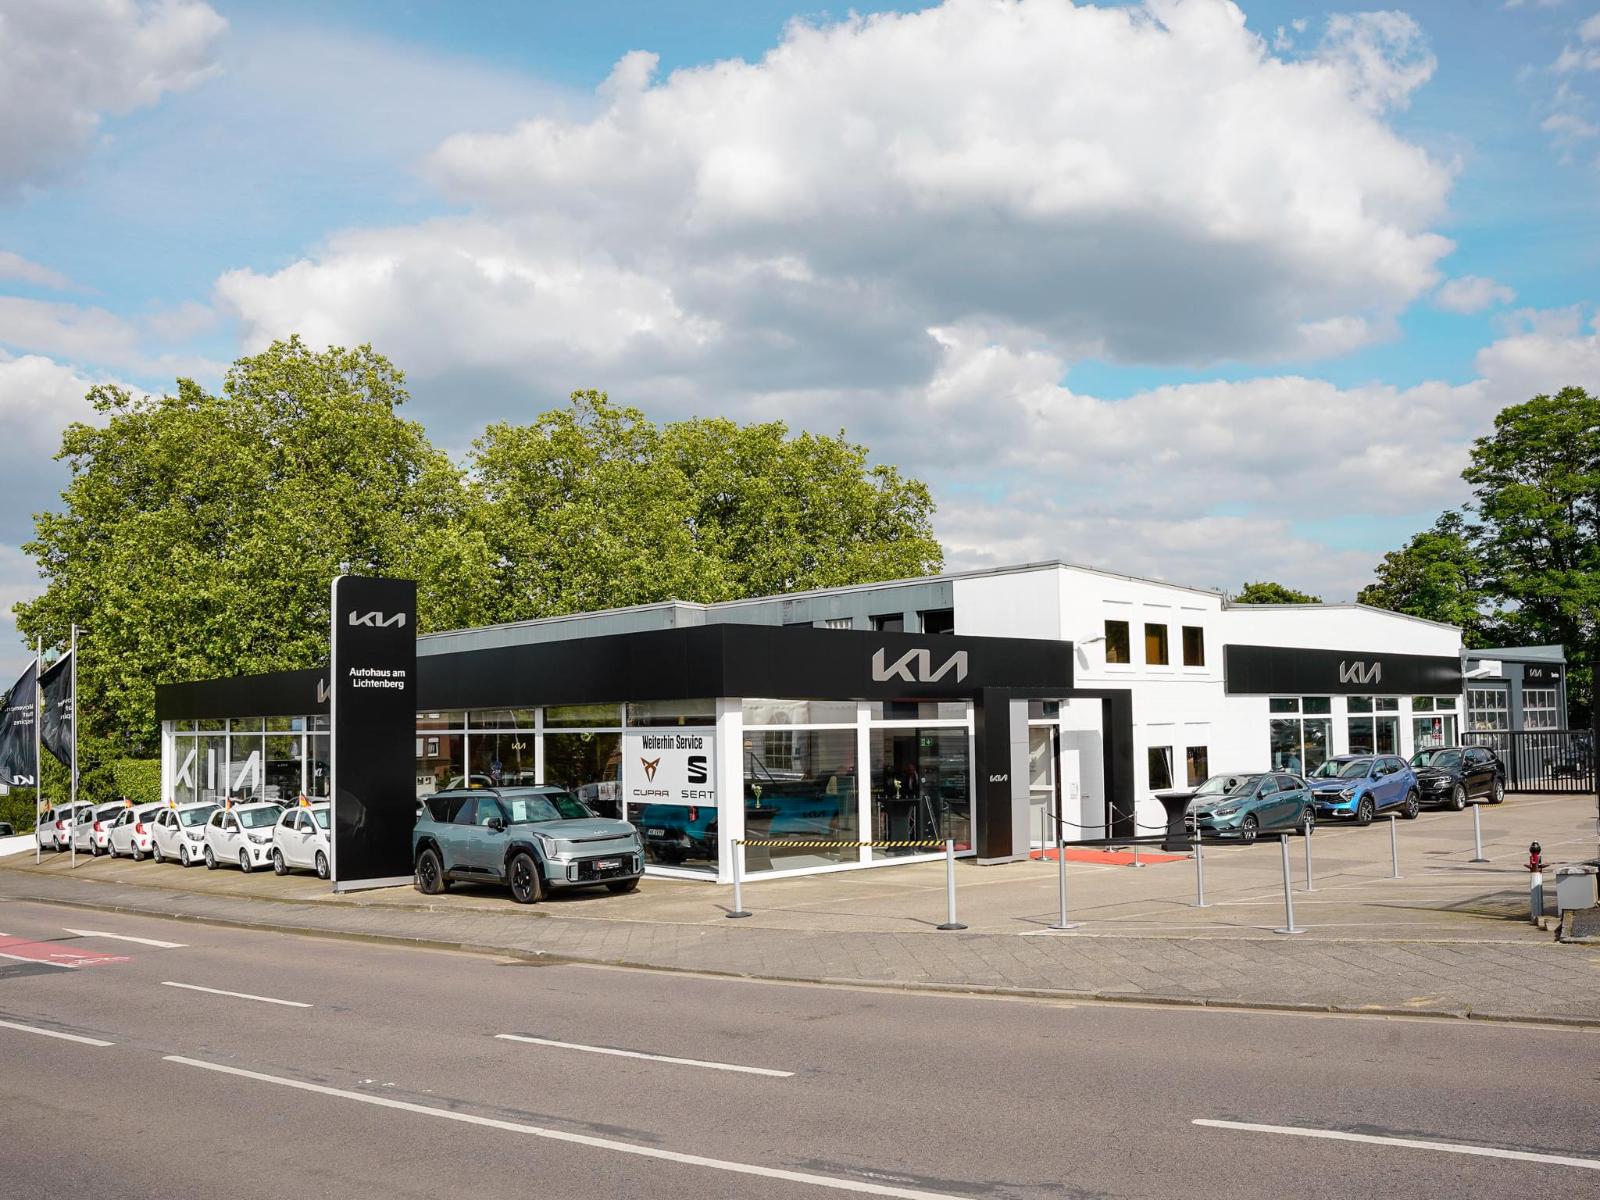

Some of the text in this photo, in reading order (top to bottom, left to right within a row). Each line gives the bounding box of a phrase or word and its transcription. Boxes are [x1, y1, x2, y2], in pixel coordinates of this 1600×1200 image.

[349, 610, 406, 628] KIA
[872, 647, 968, 683] KIA
[349, 667, 391, 677] Autohaus
[1340, 660, 1381, 684] KIA
[353, 679, 405, 690] Lichtenberg
[642, 734, 703, 750] Weiterhin Service
[989, 774, 1008, 782] KIA
[633, 789, 670, 797] CUPRA
[681, 789, 715, 799] SEAT
